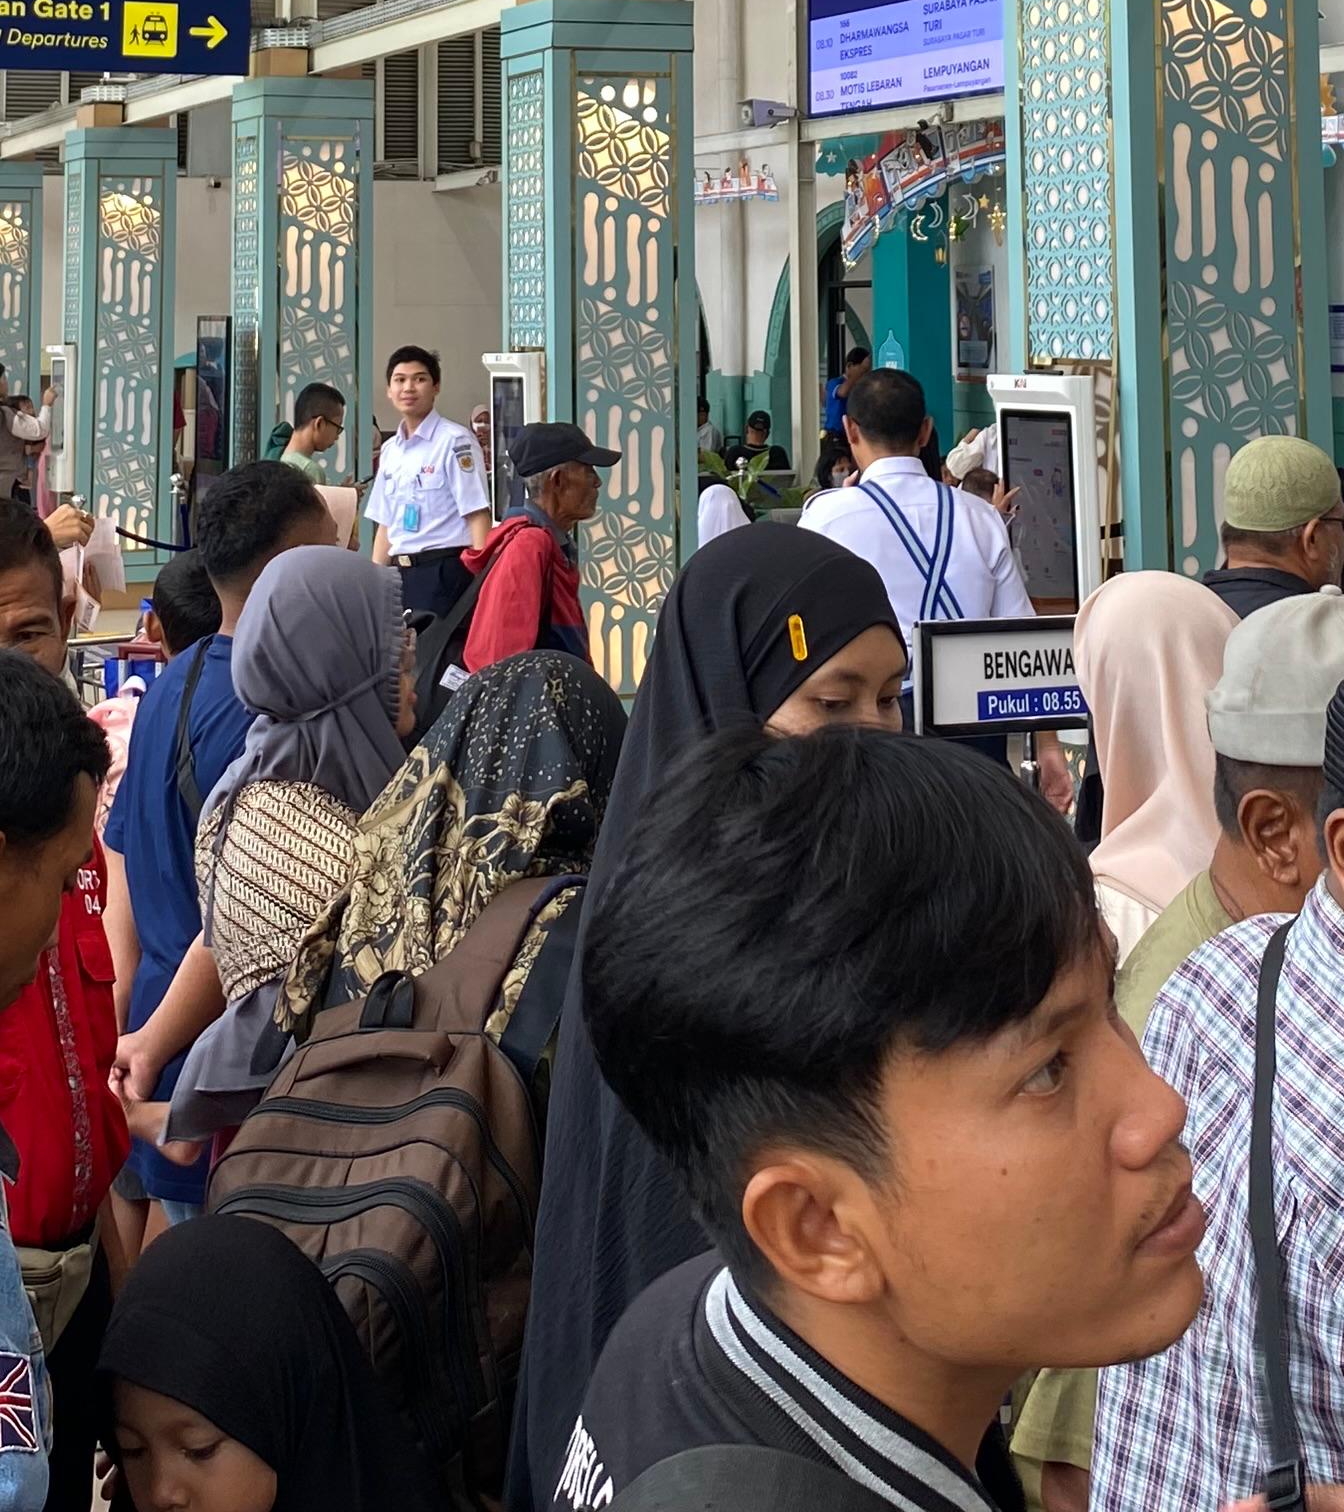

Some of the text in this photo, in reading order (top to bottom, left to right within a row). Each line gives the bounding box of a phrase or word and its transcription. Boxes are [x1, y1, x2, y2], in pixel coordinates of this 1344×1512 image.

[100, 0, 111, 21] 1
[7, 30, 109, 50] Departures
[839, 19, 943, 45] DHARMAWANGSA TURI
[840, 45, 873, 61] EKSPRES
[923, 58, 991, 80] LEMPUYANGAN
[840, 80, 865, 97] MOTIS
[866, 76, 903, 94] LEBARAN
[983, 648, 1076, 680] BENGAWA
[987, 693, 1030, 715] Pukul
[1042, 691, 1081, 712] 08.55
